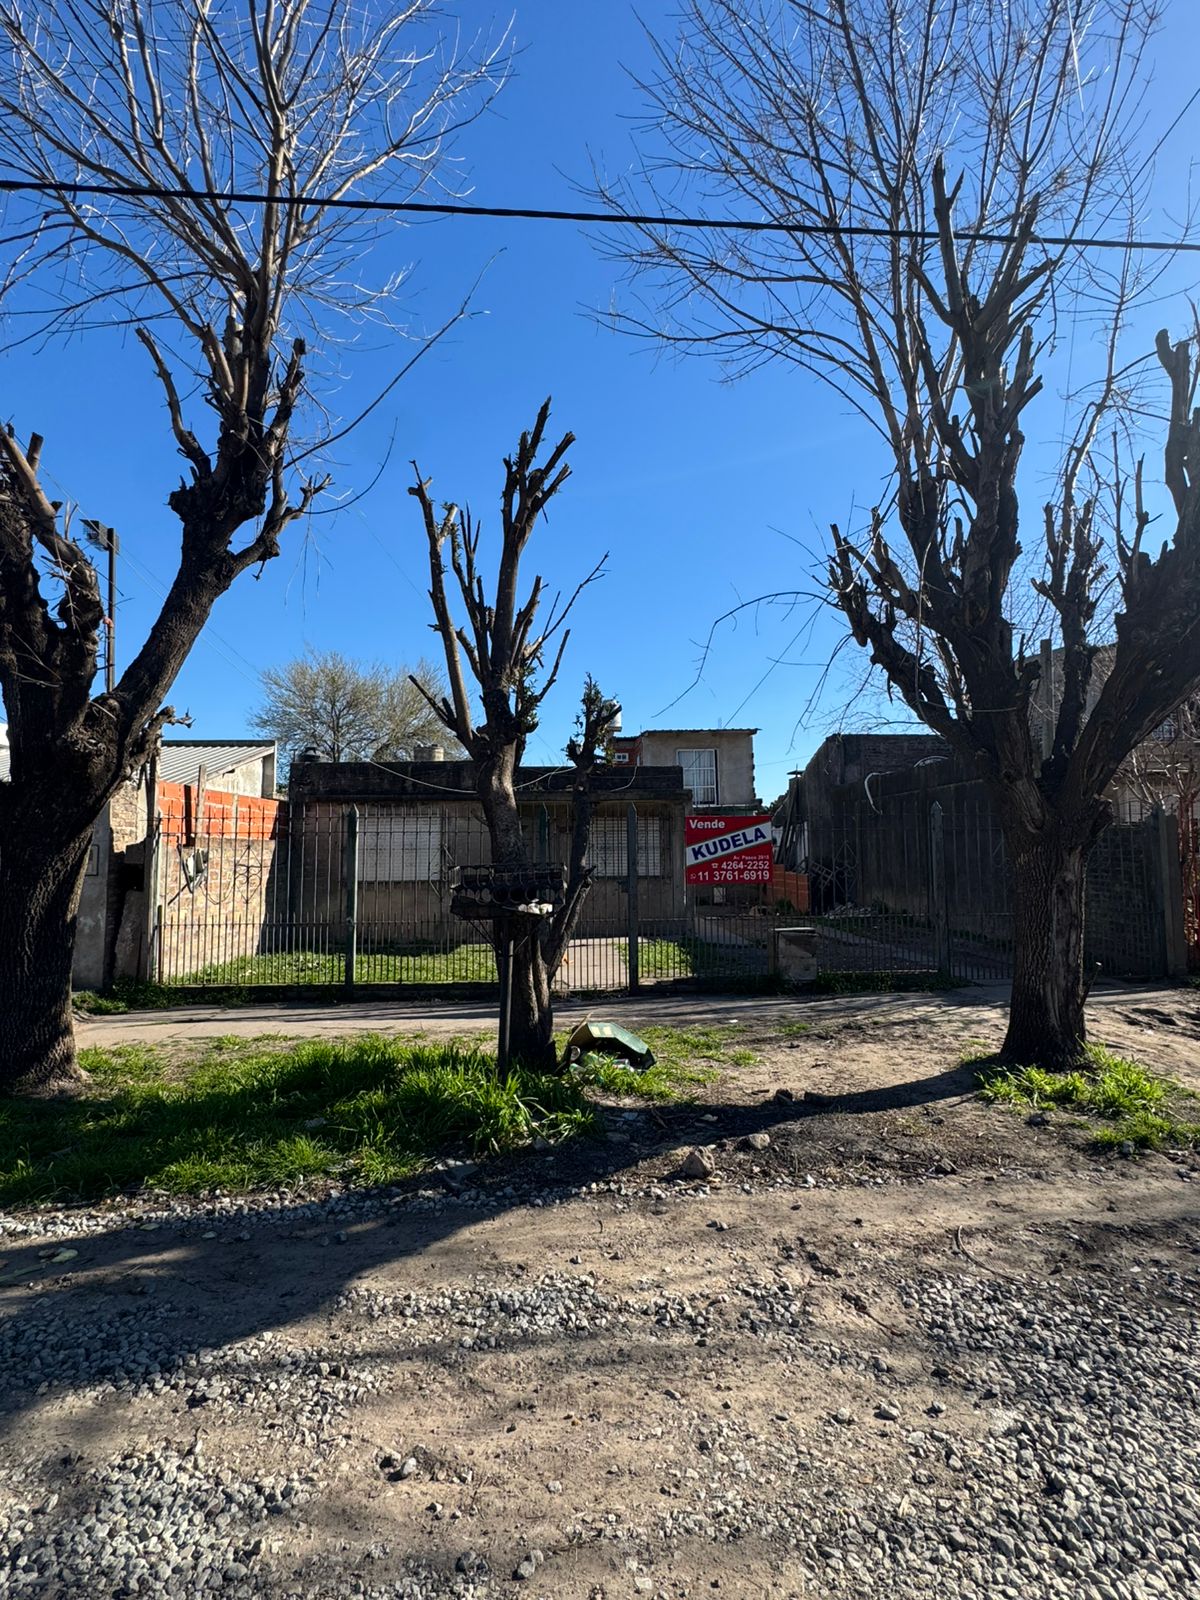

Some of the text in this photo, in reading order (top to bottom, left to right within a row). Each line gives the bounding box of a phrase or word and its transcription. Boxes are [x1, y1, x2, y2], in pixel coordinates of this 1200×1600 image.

[689, 819, 725, 829] Vende
[691, 827, 767, 861] KUDELA
[721, 861, 770, 870] 4264-2252
[698, 870, 770, 881] 11 3761-6919
